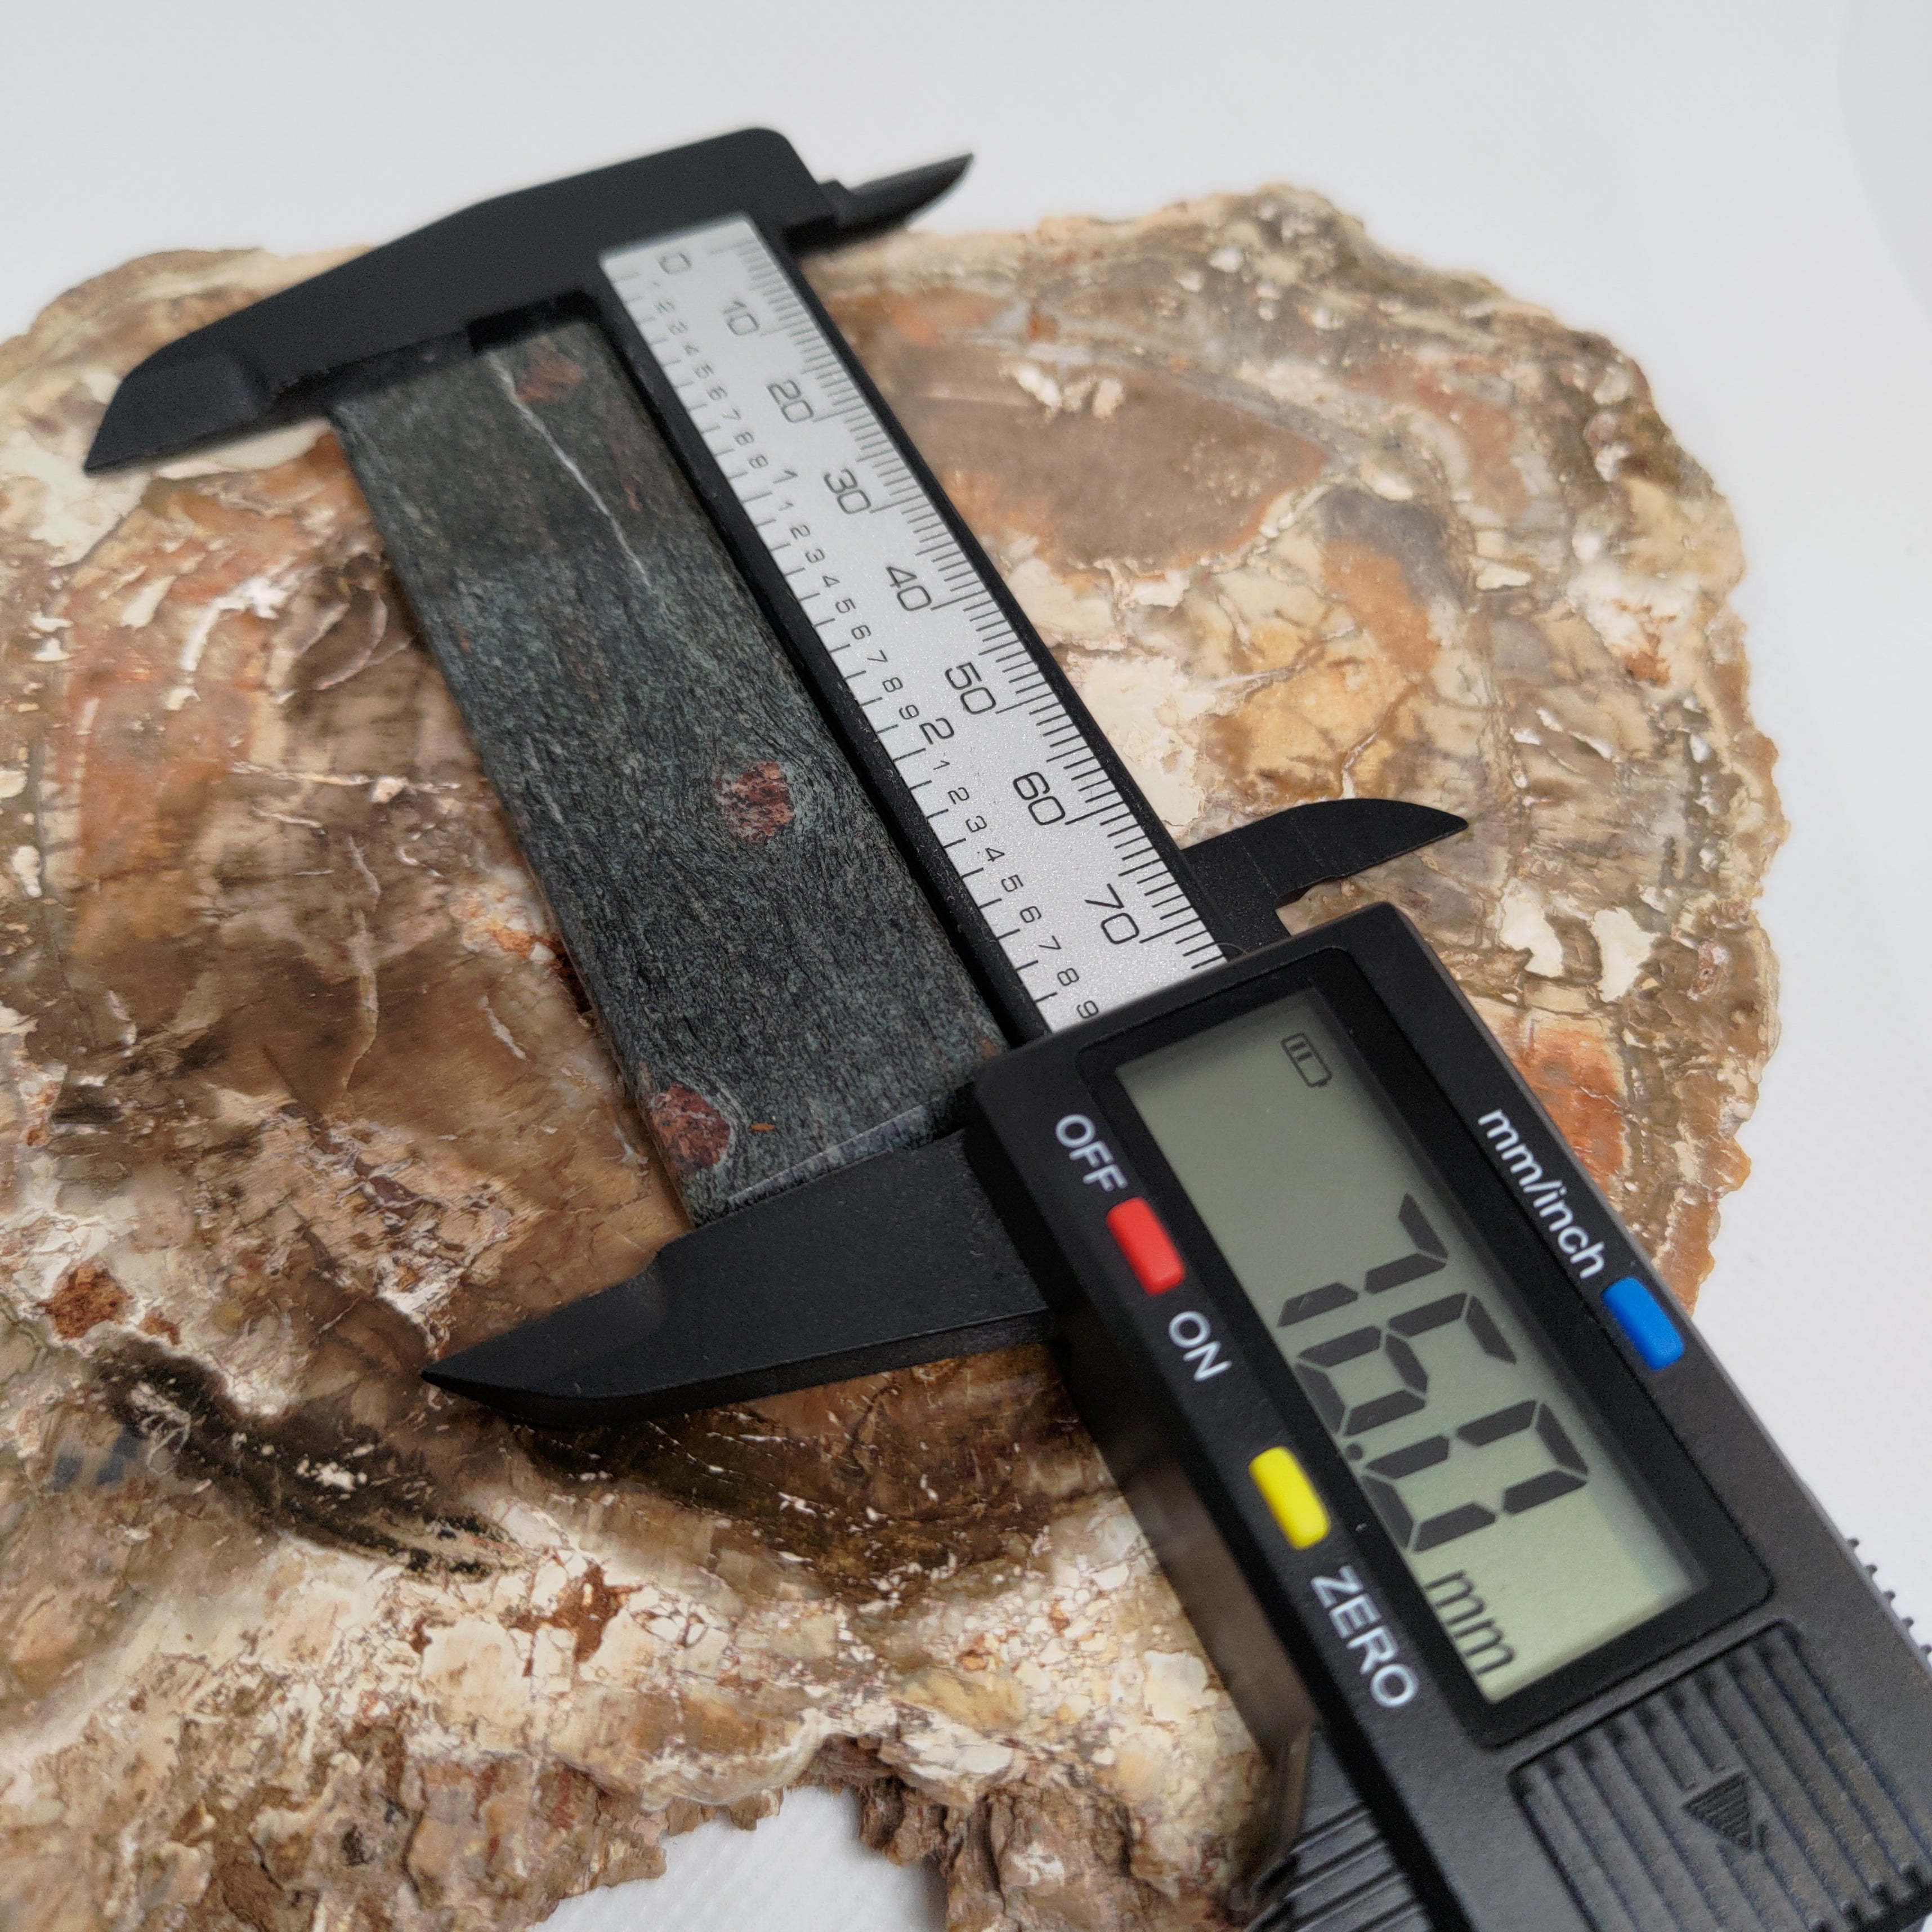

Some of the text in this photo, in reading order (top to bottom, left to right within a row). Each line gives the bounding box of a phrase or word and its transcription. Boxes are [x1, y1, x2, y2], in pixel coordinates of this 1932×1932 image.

[659, 253, 692, 274] 0
[721, 300, 759, 336] 10
[683, 344, 700, 356] 4
[694, 364, 714, 379] 5
[708, 386, 728, 401] 6
[767, 379, 814, 423] 20
[722, 408, 741, 421] 7
[734, 431, 754, 445] 8
[772, 468, 798, 484] 1
[824, 468, 871, 515] 30
[778, 500, 794, 512] 1
[790, 525, 811, 540] 2
[805, 548, 825, 563] 3
[822, 575, 840, 588] 4
[886, 566, 932, 612] 40
[835, 598, 856, 614] 5
[851, 625, 871, 640] 6
[867, 650, 888, 663] 7
[882, 677, 904, 693] 8
[945, 662, 997, 715] 50
[898, 704, 919, 720] 9
[919, 718, 955, 744] 2
[933, 760, 950, 770] 1
[947, 787, 970, 804] 2
[1013, 772, 1066, 826] 60
[965, 815, 987, 833] 3
[985, 847, 1005, 862] 4
[1001, 874, 1024, 892] 5
[1019, 905, 1042, 924] 6
[1084, 883, 1140, 945] 70
[1039, 935, 1062, 950] 7
[1057, 968, 1080, 986] 8
[1076, 1000, 1099, 1019] 9
[1053, 1113, 1129, 1194] OFF
[1477, 1108, 1607, 1281] mm/inch
[1167, 1311, 1233, 1383] ON
[1277, 1192, 1589, 1676] 76.0 mm
[1311, 1566, 1420, 1708] ZERO
